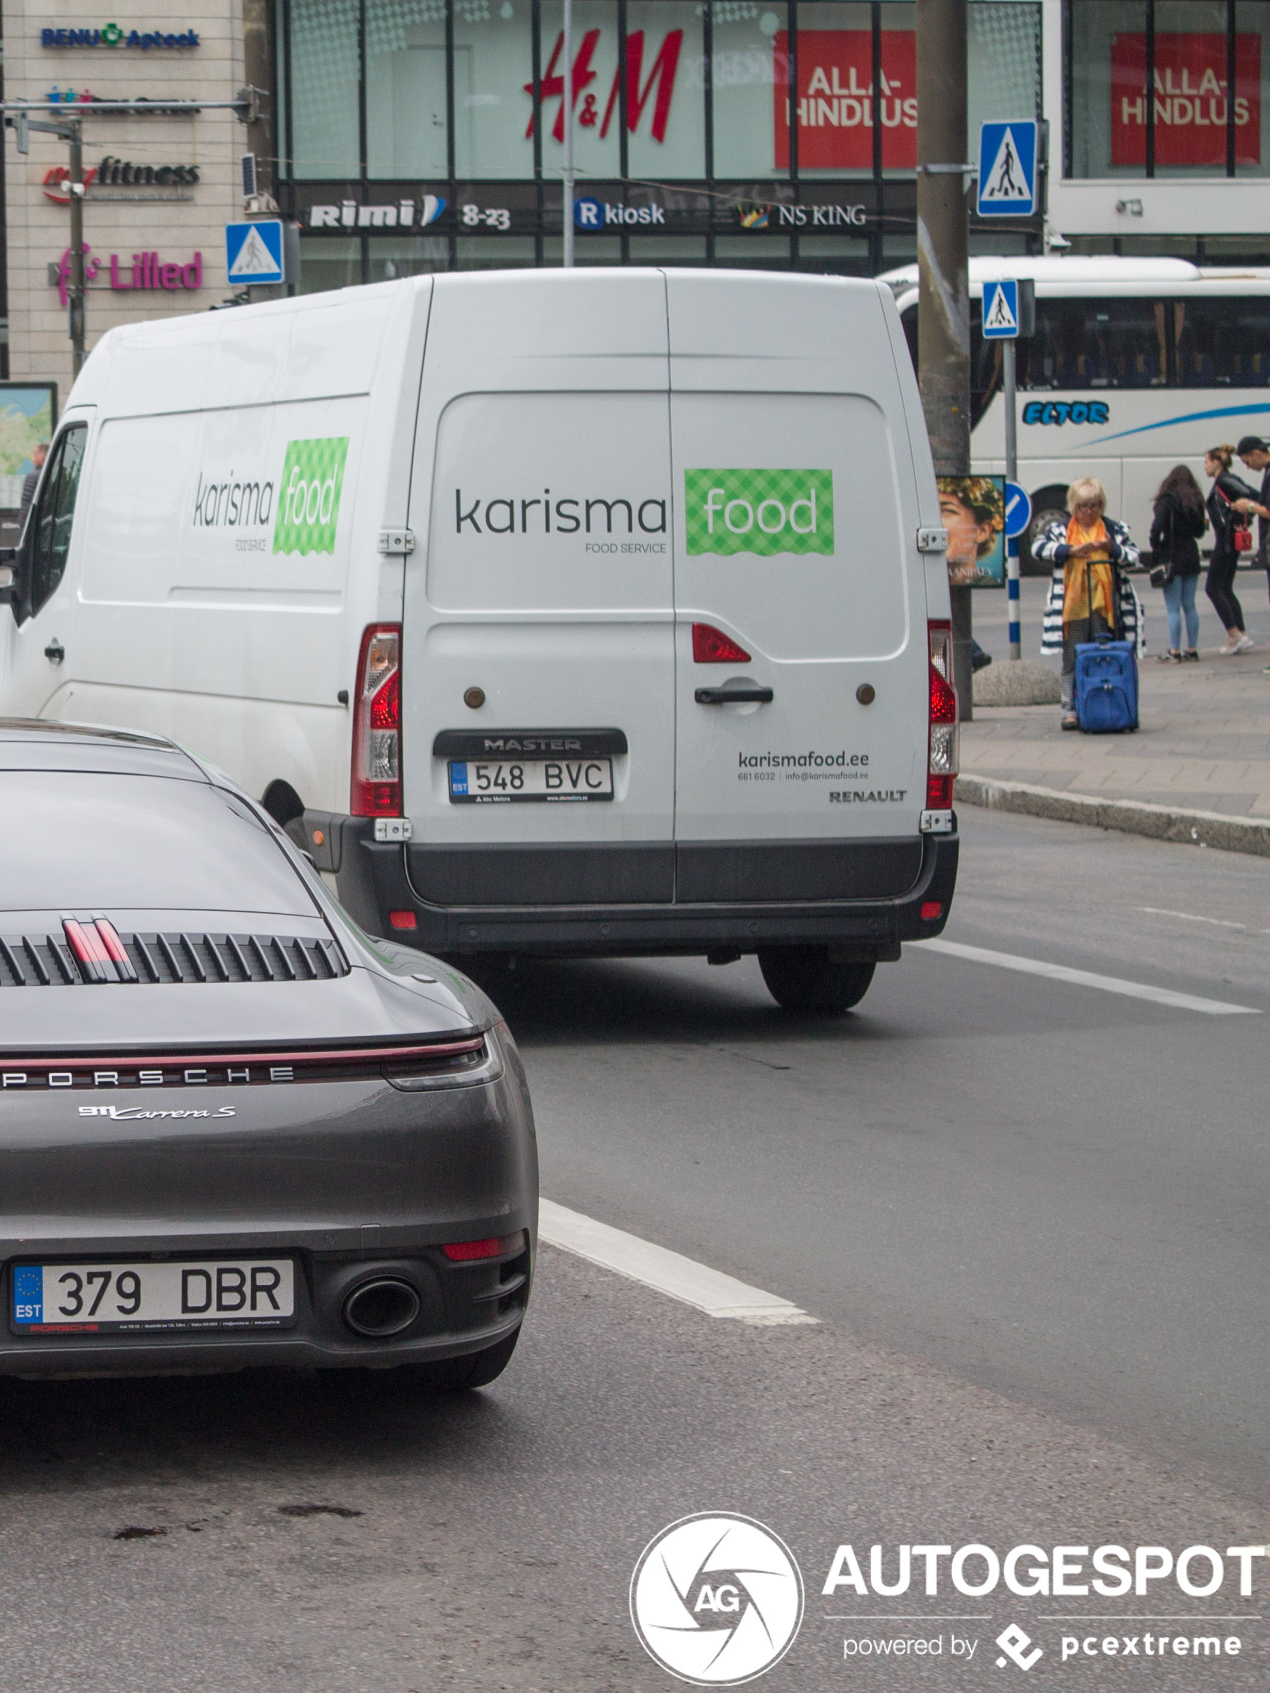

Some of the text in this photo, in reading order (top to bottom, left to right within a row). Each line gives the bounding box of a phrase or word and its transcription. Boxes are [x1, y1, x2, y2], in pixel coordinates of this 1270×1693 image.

[41, 28, 200, 51] BENU Apteek
[523, 28, 684, 144] H&M
[808, 66, 902, 96] ALLA-
[1122, 97, 1249, 126] HINDLUS
[463, 205, 511, 230] 8-23
[580, 203, 665, 224] R kiosk
[780, 205, 866, 225] NS KING
[110, 252, 202, 289] Lilled
[1022, 401, 1109, 426] ELTOR
[193, 464, 338, 527] karisma food
[456, 488, 817, 534] karisma food
[585, 543, 667, 554] FOOD SERVICE
[484, 739, 581, 751] MASTER
[739, 751, 869, 767] karismafood.ee
[453, 764, 603, 792] EST 548 BVC
[738, 773, 752, 781] 661
[754, 772, 775, 781] 6032
[829, 790, 907, 803] RENAULT
[2, 1067, 294, 1087] PORSCHE
[78, 1105, 236, 1120] 911 Carrera S
[16, 1267, 281, 1318] EST 379 DBR
[30, 1324, 99, 1332] PORSCHE
